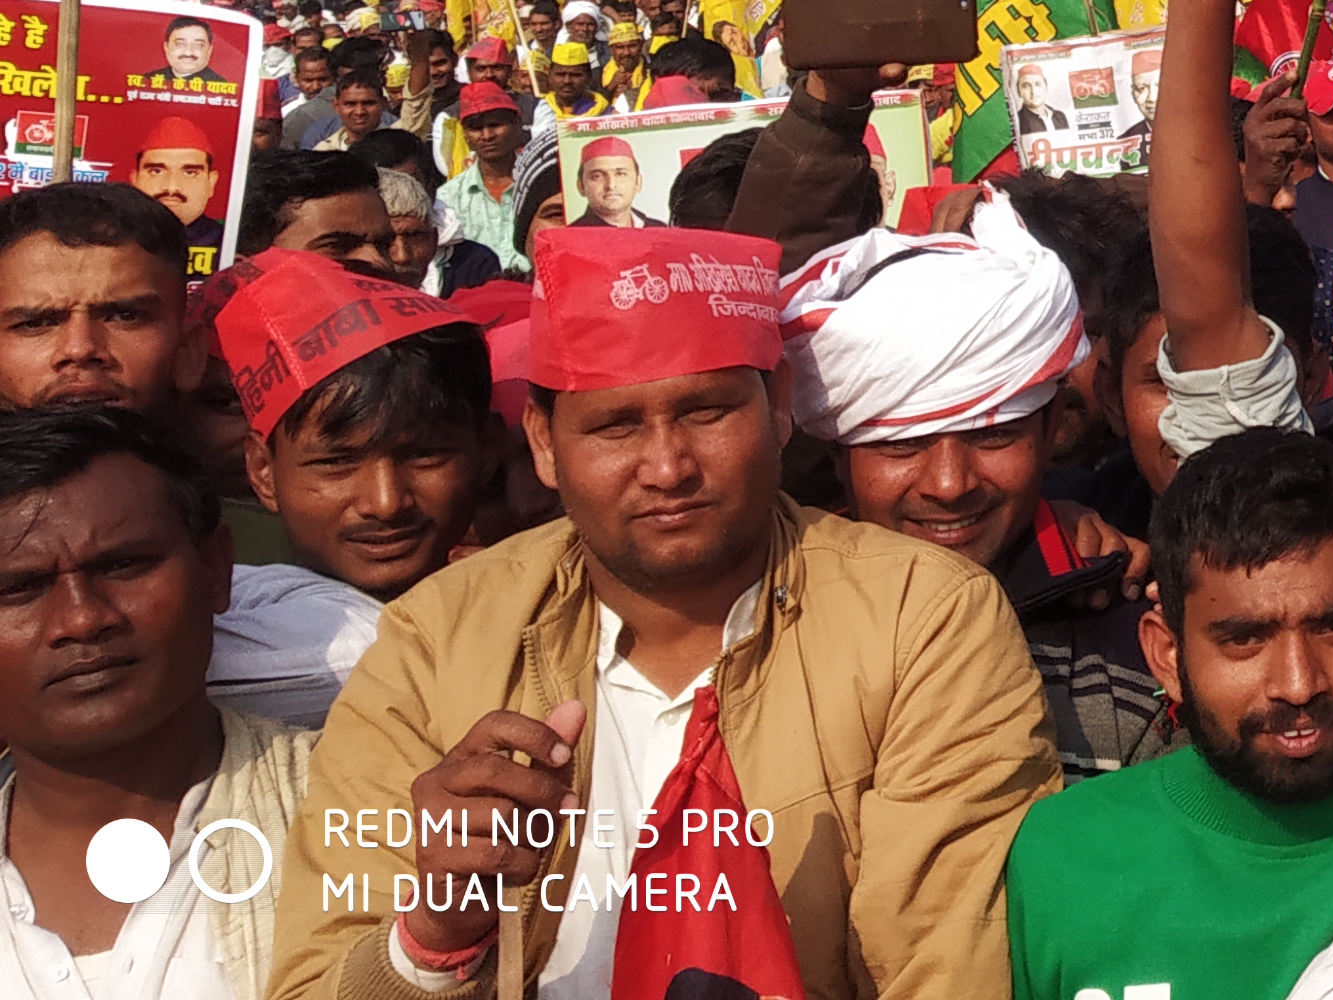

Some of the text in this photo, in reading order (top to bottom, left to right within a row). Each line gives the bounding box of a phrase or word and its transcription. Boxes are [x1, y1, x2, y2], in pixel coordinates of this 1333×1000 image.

[205, 80, 239, 96] यादव
[596, 117, 640, 132] अखिलेश
[1098, 128, 1115, 140] 372
[292, 297, 383, 363] बाबा
